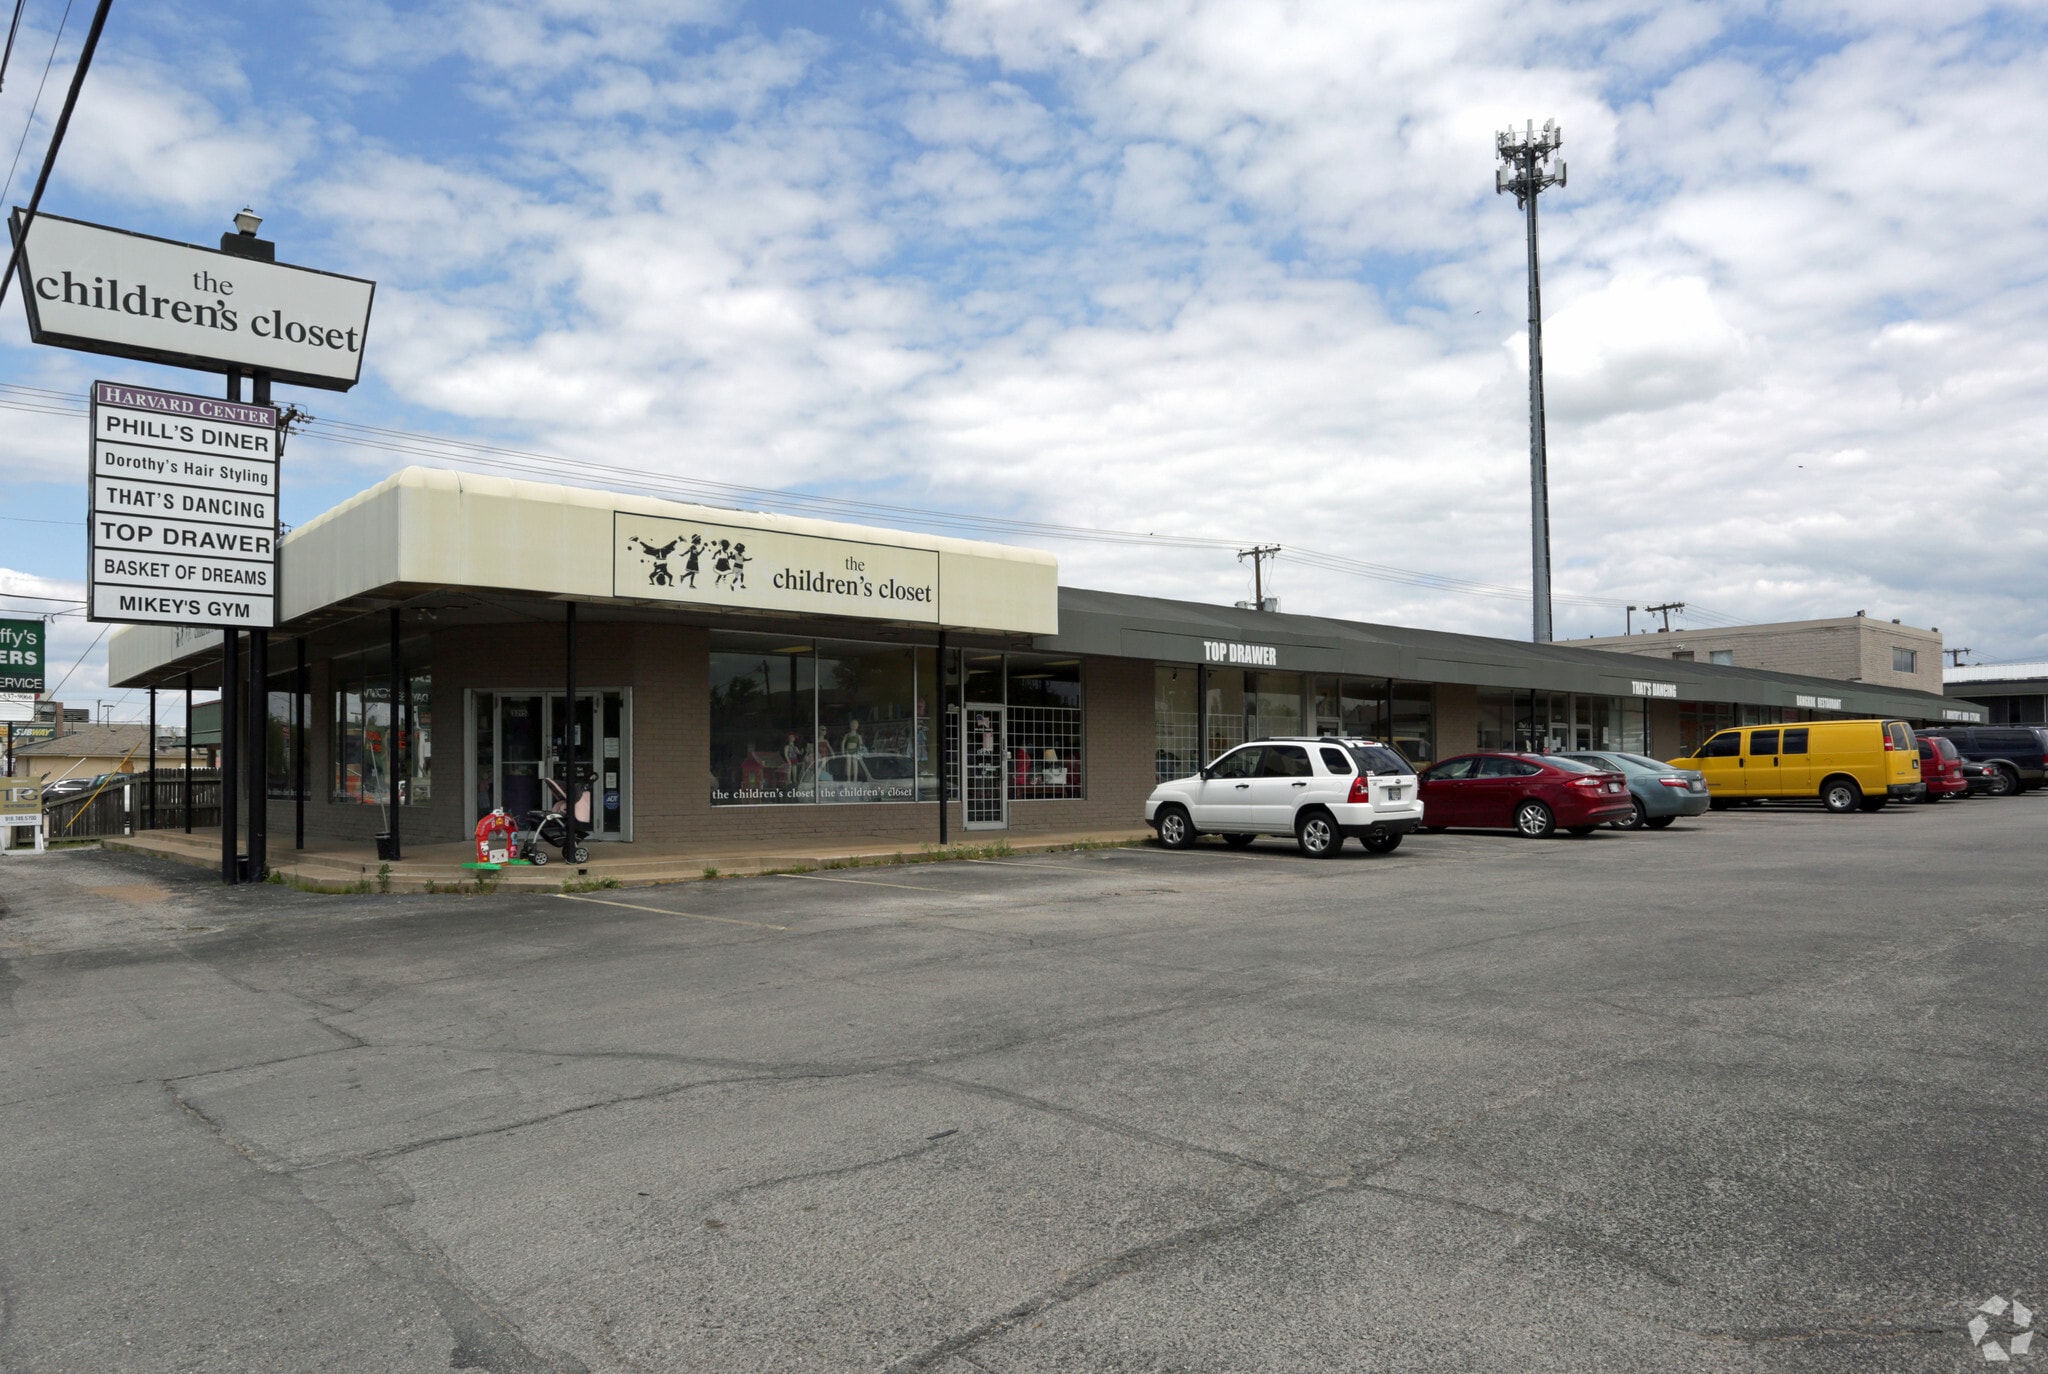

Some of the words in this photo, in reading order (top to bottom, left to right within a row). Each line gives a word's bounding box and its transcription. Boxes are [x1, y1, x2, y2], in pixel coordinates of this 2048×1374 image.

[193, 270, 234, 296] the
[36, 271, 238, 332] children's
[251, 310, 359, 353] closet
[105, 387, 194, 414] HARVARD
[200, 401, 269, 424] CENTER
[106, 416, 194, 442] PHILL'S
[202, 429, 268, 452] DINER
[105, 452, 178, 474] Dorothy's
[184, 462, 214, 478] Hair
[220, 466, 268, 486] Styling
[106, 487, 174, 510] THAT'S
[182, 495, 265, 519] DANCING
[100, 522, 153, 542] TOP
[163, 528, 271, 554] DRAWER
[104, 558, 170, 578] BASKET
[175, 565, 197, 580] OF
[202, 567, 267, 586] DREAMS
[845, 556, 865, 572] the
[773, 568, 872, 597] children's
[879, 578, 932, 602] closet
[120, 595, 200, 615] MIKEY'S
[208, 601, 250, 618] GYM
[0, 650, 37, 666] ERS
[1204, 641, 1227, 662] TOP
[1229, 643, 1276, 666] DRAWER
[1632, 680, 1652, 696] THAT'S
[1652, 682, 1676, 698] DANCING
[13, 728, 54, 736] SUBWAY
[712, 790, 729, 799] the
[733, 788, 784, 799] children's
[787, 789, 814, 798] closet
[820, 788, 836, 798] the
[840, 787, 884, 798] children's
[888, 787, 912, 796] closet
